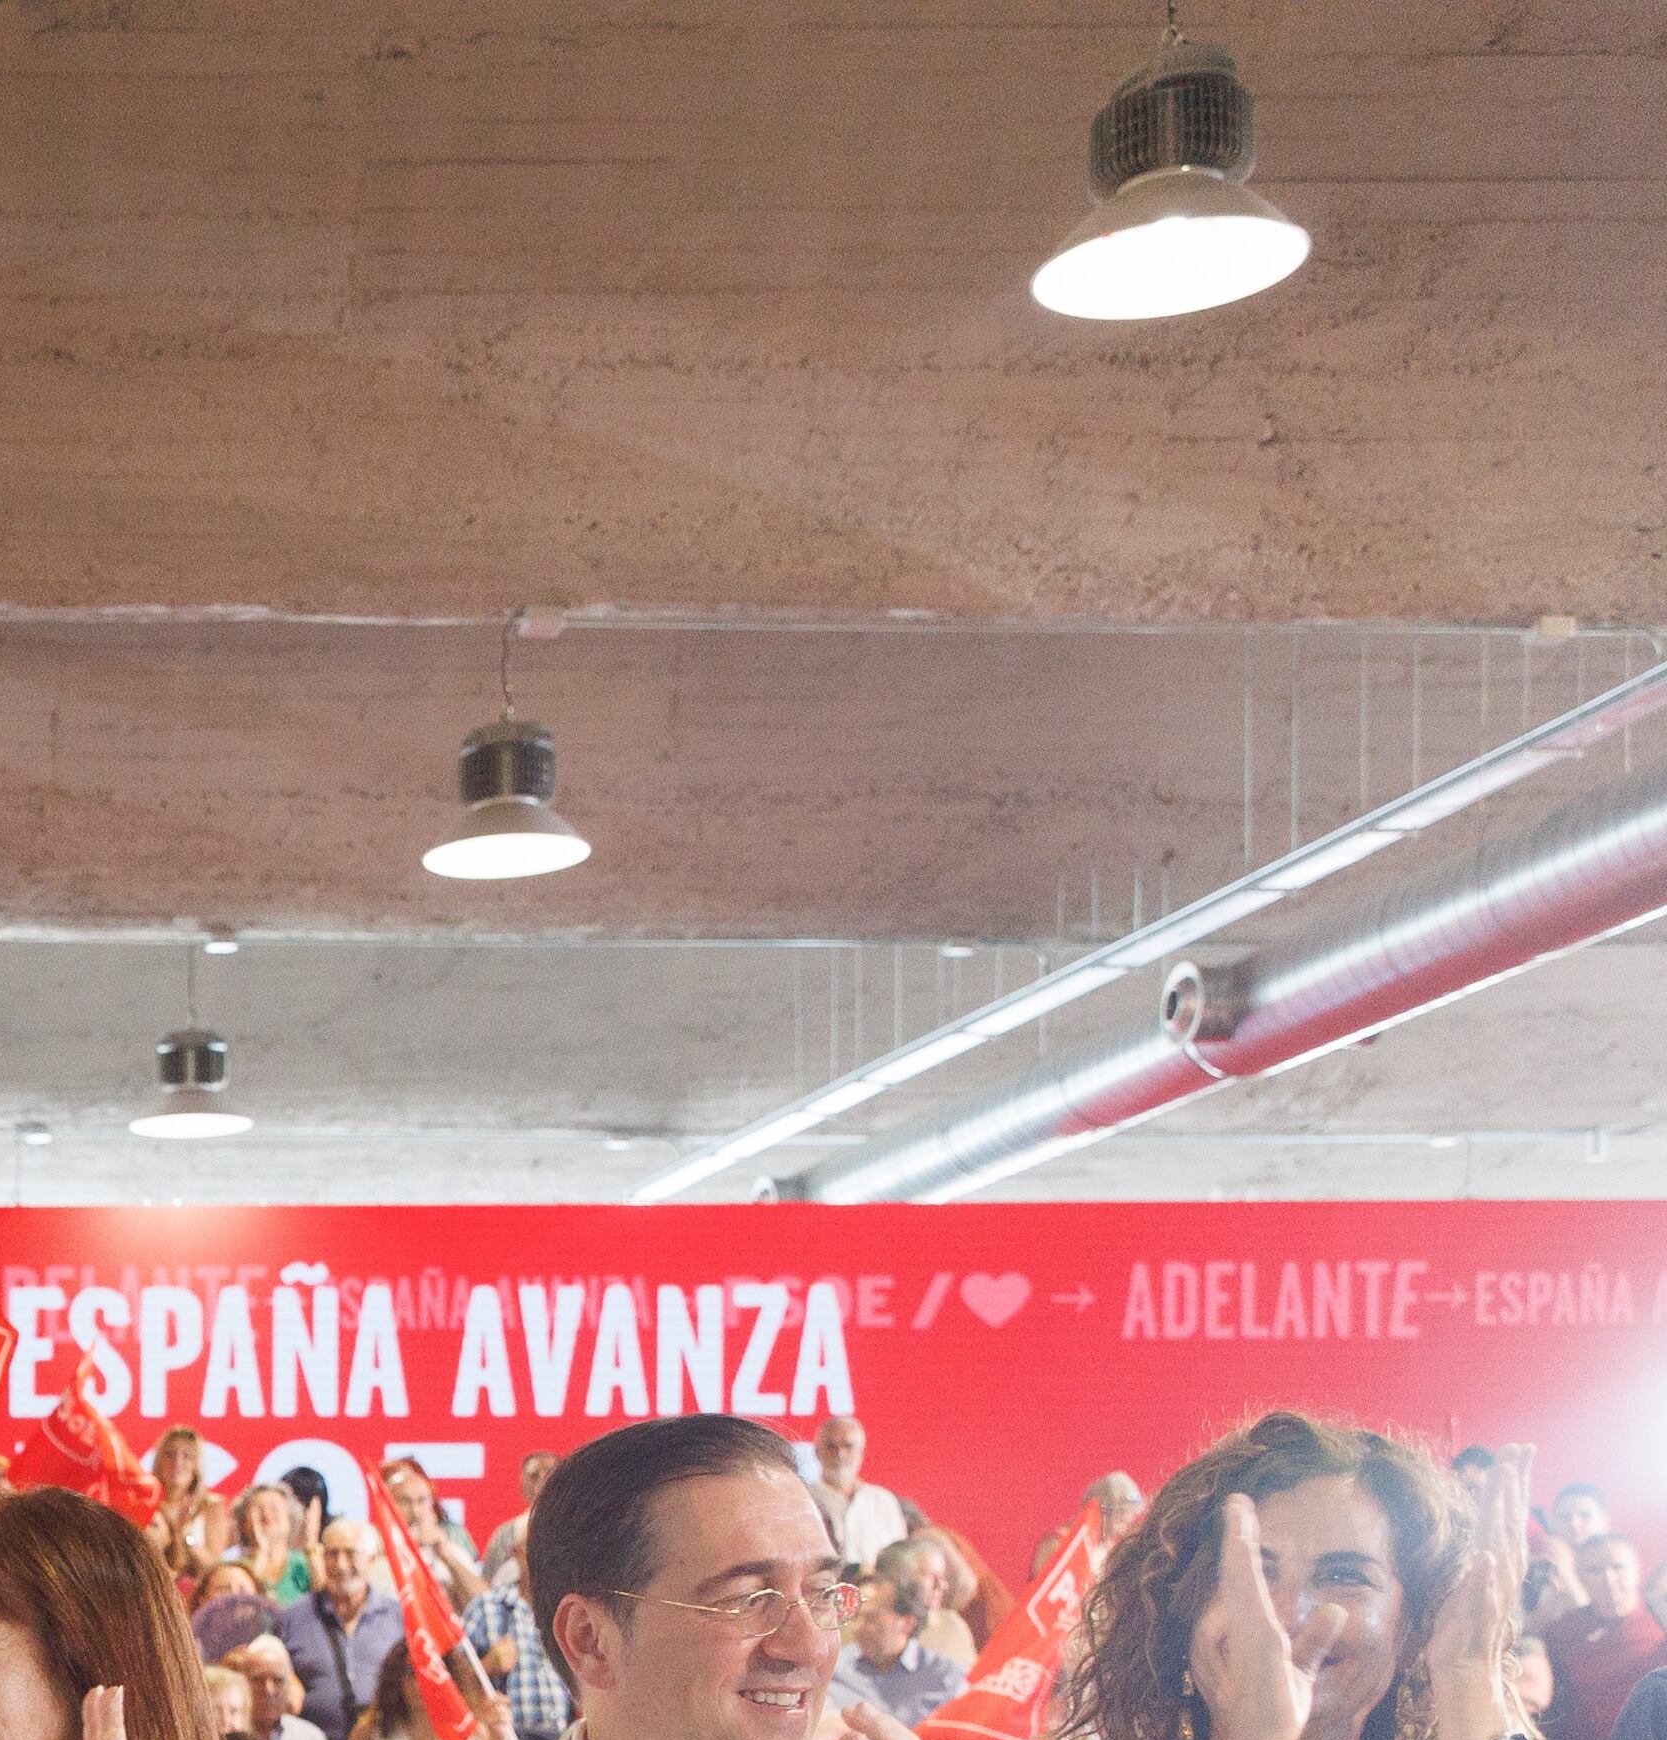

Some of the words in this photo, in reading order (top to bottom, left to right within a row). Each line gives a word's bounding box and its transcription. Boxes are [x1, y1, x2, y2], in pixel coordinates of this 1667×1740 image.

[8, 1260, 409, 1418] ESPAÑA
[451, 1284, 855, 1417] AVANZA
[1121, 1261, 1430, 1339] ADELANTE
[1474, 1263, 1634, 1325] ESPAÑA
